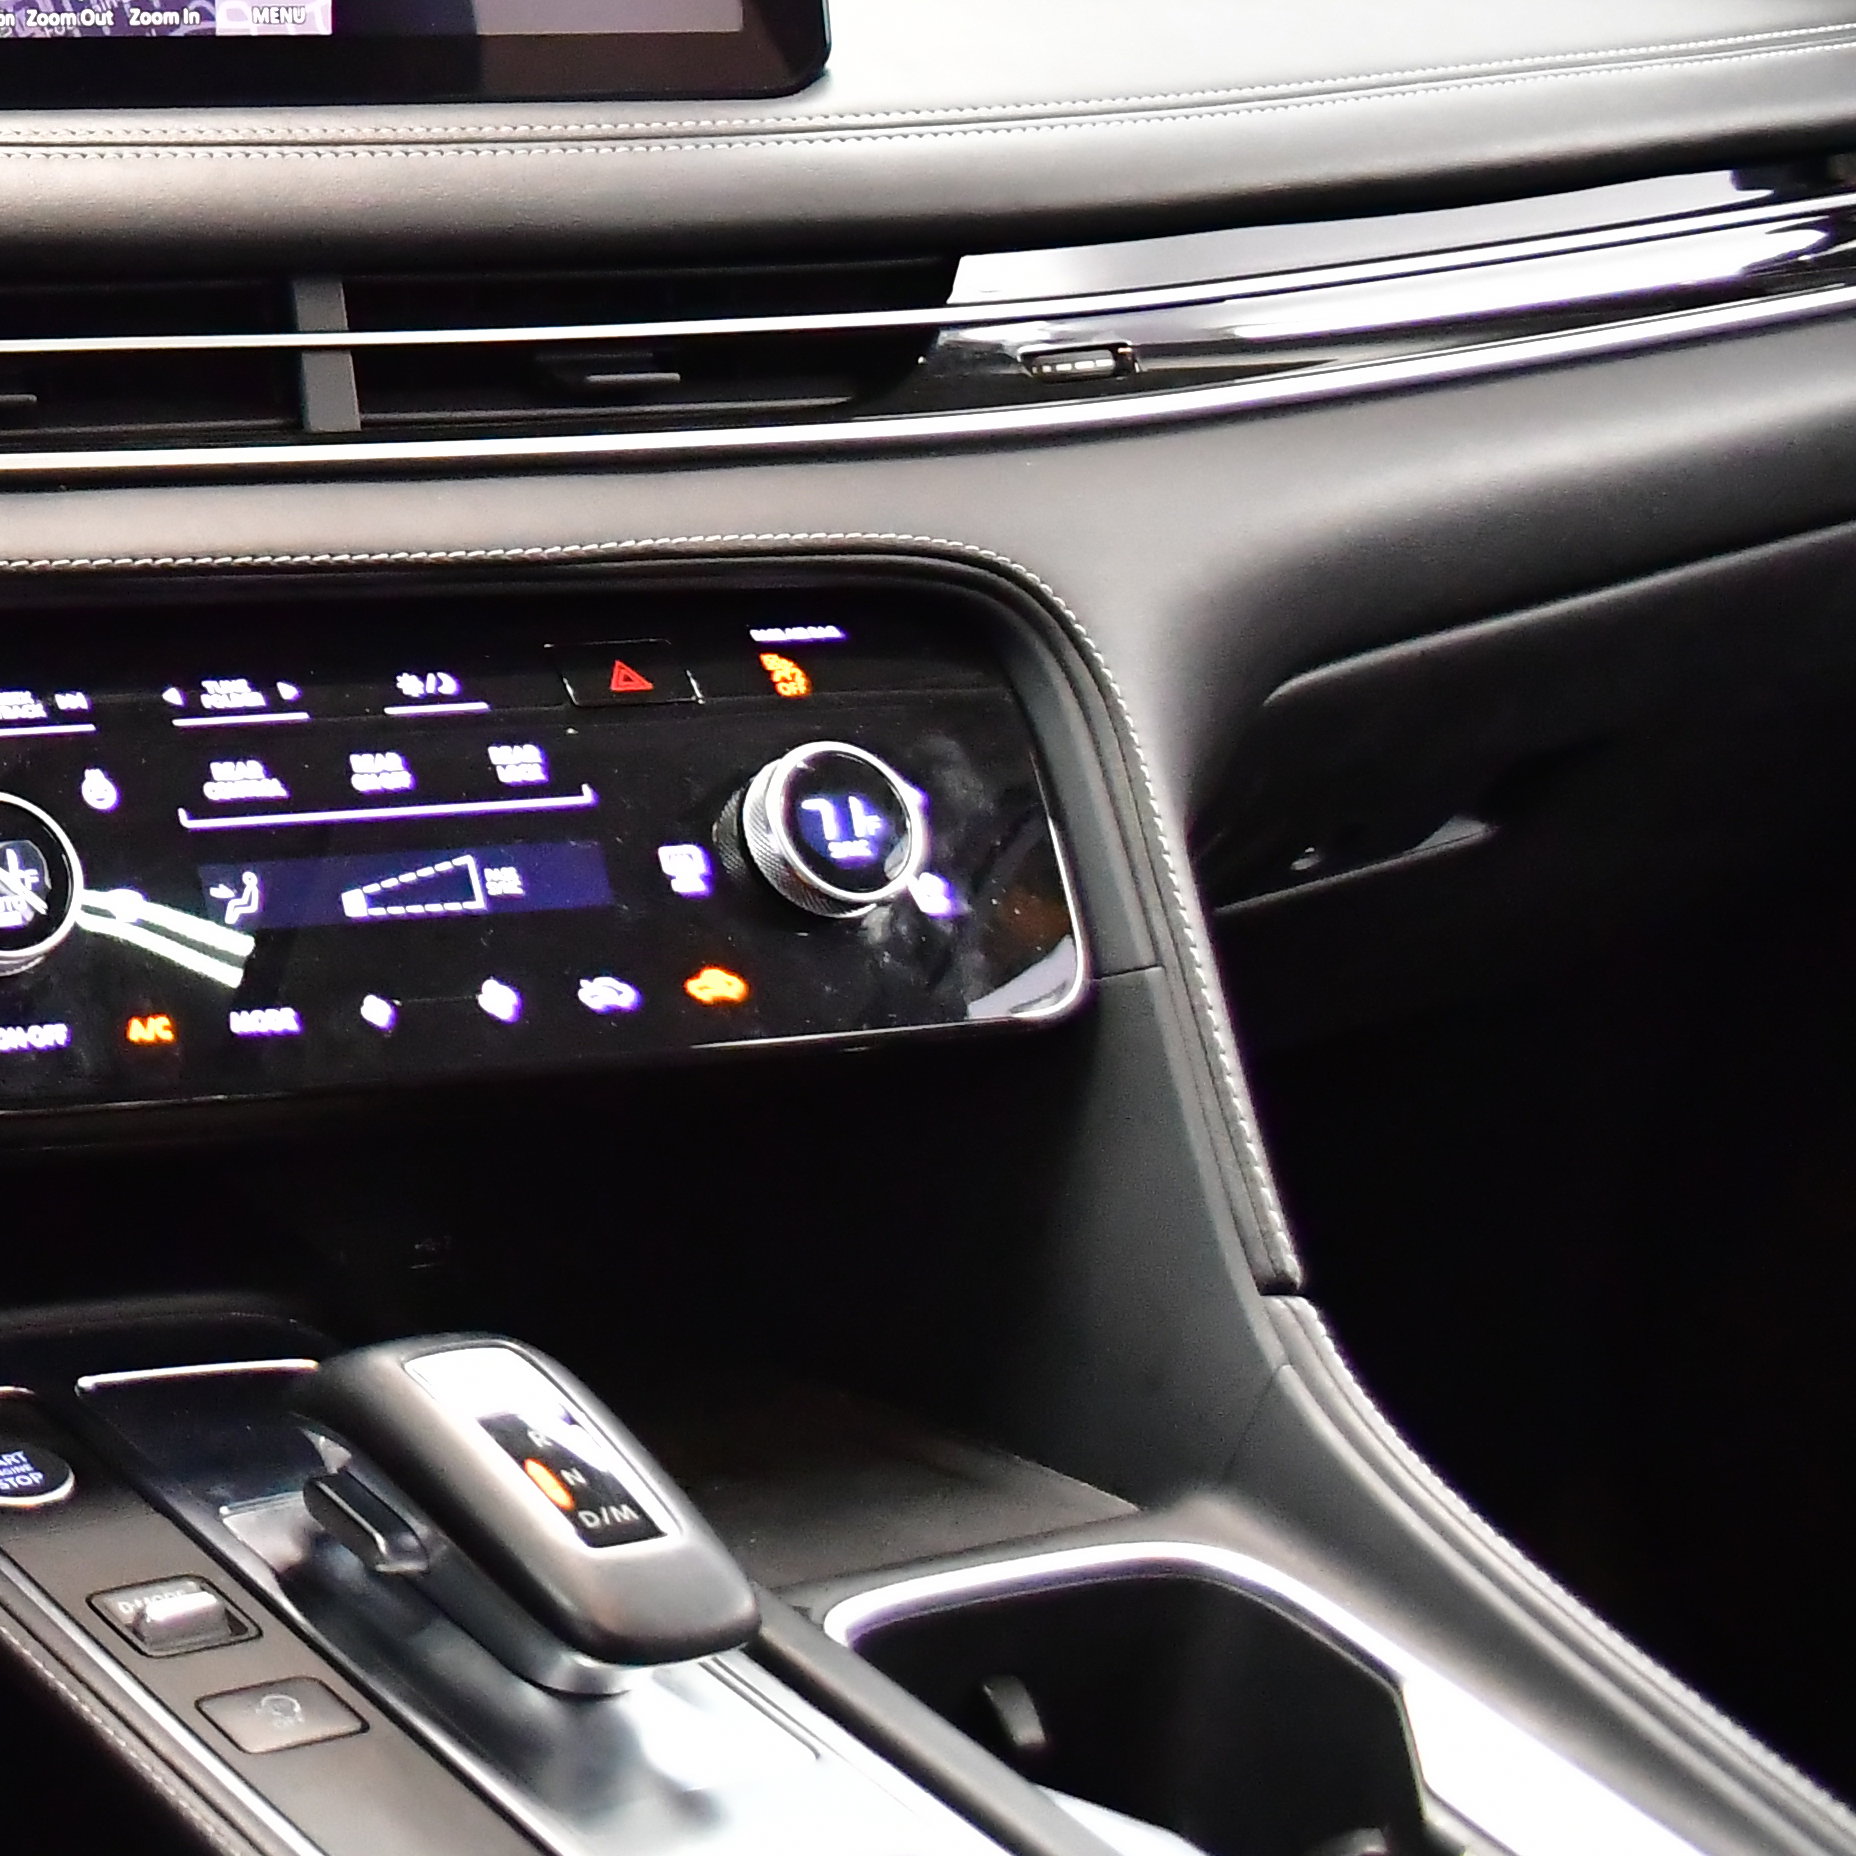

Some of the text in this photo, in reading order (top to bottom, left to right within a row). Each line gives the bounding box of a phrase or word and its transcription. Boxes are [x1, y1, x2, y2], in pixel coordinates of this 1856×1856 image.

[26, 10, 77, 28] Zoom
[79, 8, 115, 28] Out
[128, 7, 201, 27] Zoom In
[250, 5, 307, 25] MENU
[127, 1013, 175, 1044] A/C
[560, 1467, 586, 1486] N
[578, 1504, 639, 1529] D/M
